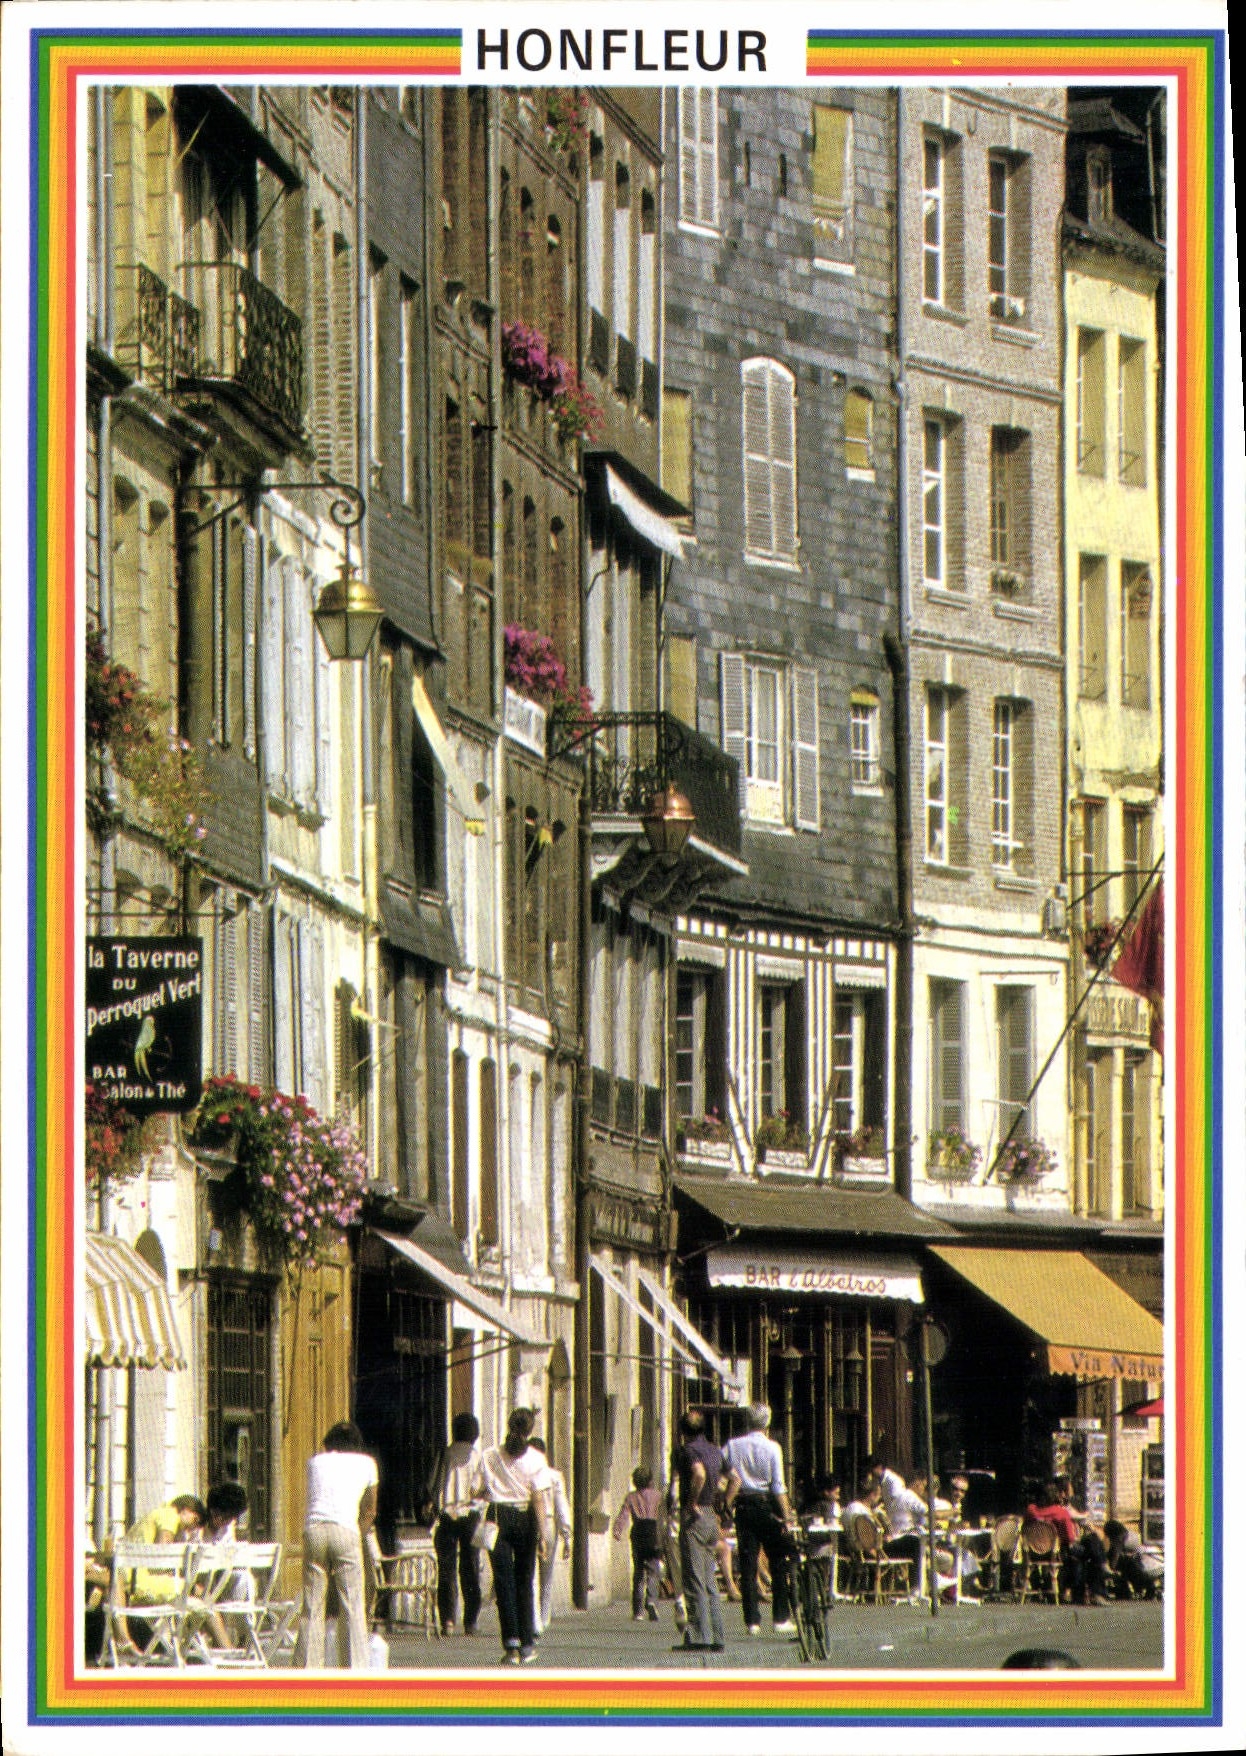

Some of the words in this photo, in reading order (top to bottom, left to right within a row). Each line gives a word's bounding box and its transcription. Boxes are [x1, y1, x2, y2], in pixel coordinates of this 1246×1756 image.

[88, 945, 105, 968] la
[111, 944, 200, 969] Taverne
[112, 976, 137, 991] DU
[167, 971, 202, 1003] Vert
[92, 1065, 127, 1080] BAR
[745, 1264, 781, 1286] BAR
